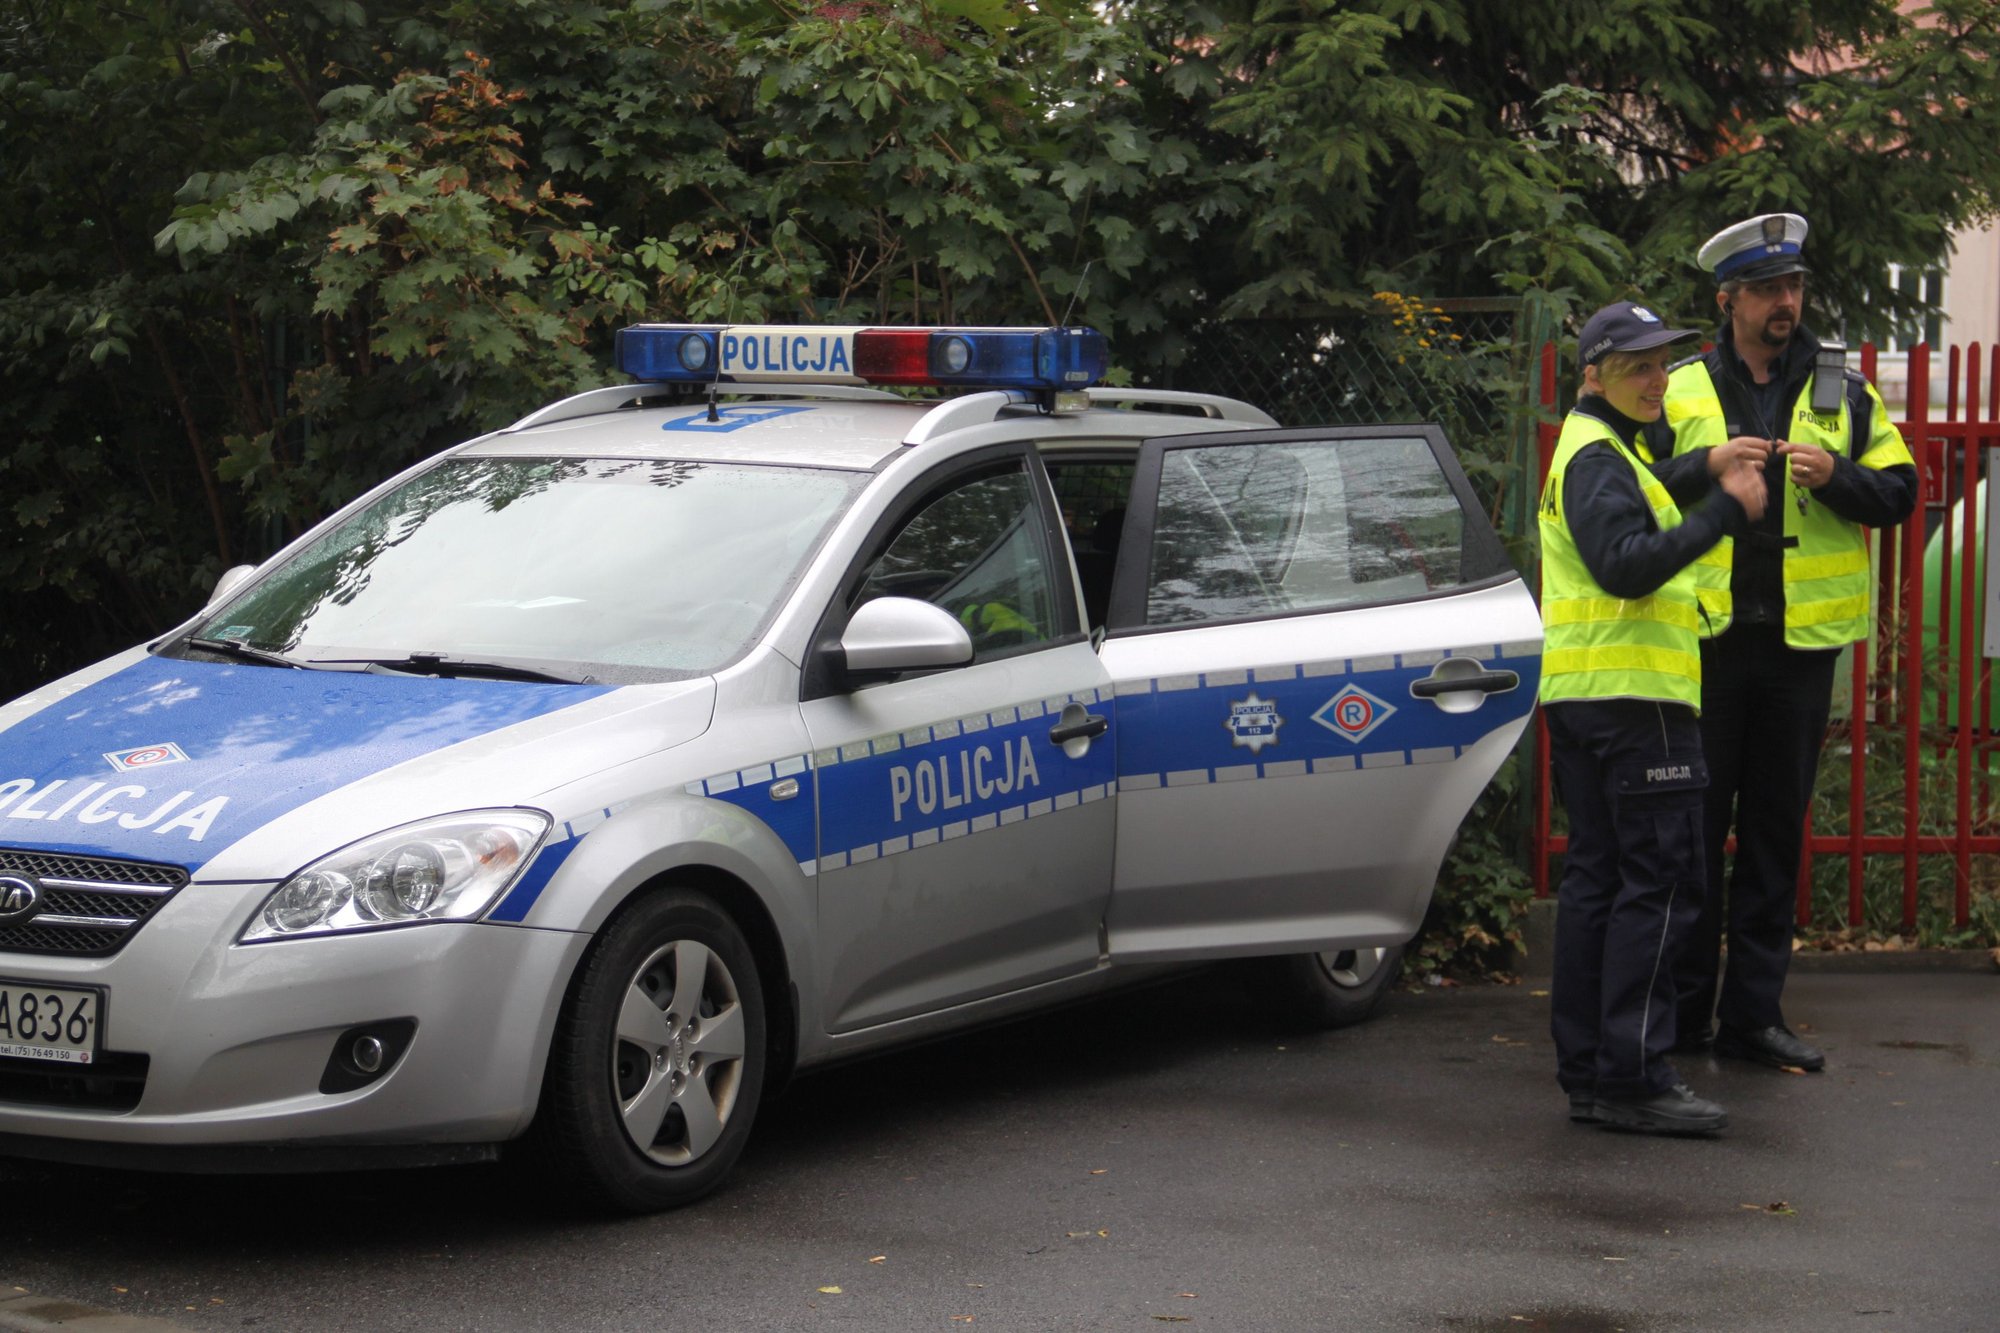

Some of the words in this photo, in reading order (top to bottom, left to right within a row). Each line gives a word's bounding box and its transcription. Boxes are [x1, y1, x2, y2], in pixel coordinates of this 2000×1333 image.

[723, 336, 850, 372] POLICJA
[1236, 706, 1272, 714] POLICJA
[1344, 704, 1361, 723] R
[890, 735, 1040, 822] POLICJA
[1646, 765, 1691, 782] POLICJA
[0, 990, 89, 1045] A836
[1, 1046, 13, 1055] tel.
[15, 1046, 31, 1056] (75)
[32, 1048, 42, 1057] 76
[44, 1049, 53, 1058] 49
[56, 1050, 70, 1060] 150
